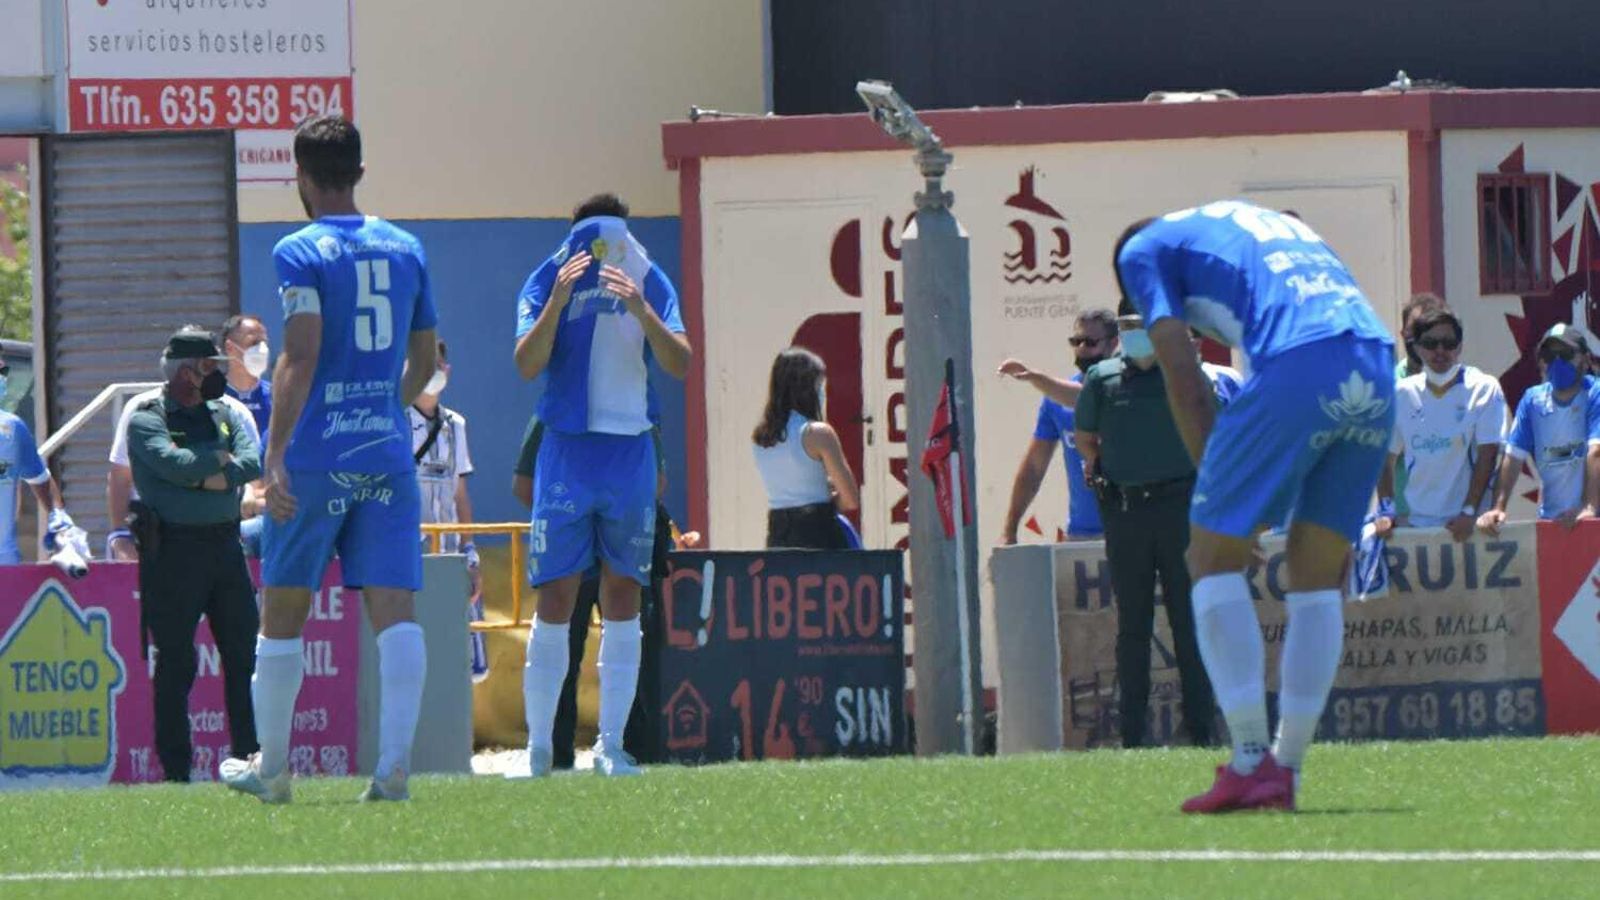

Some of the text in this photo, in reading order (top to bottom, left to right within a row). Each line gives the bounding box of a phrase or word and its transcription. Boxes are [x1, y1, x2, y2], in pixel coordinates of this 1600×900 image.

[88, 29, 325, 52] servicios hosteleros
[80, 84, 343, 125] Tlfn. 635 358 594
[354, 258, 393, 351] 5
[1387, 541, 1521, 592] RUIZ
[726, 558, 893, 640] LÍBERO!
[10, 659, 98, 693] TENGO
[1406, 650, 1417, 667] Y
[1424, 643, 1487, 667] VIGAS
[9, 706, 100, 740] MUEBLE
[835, 686, 892, 747] SIN
[1332, 686, 1537, 736] 957 60 18 85
